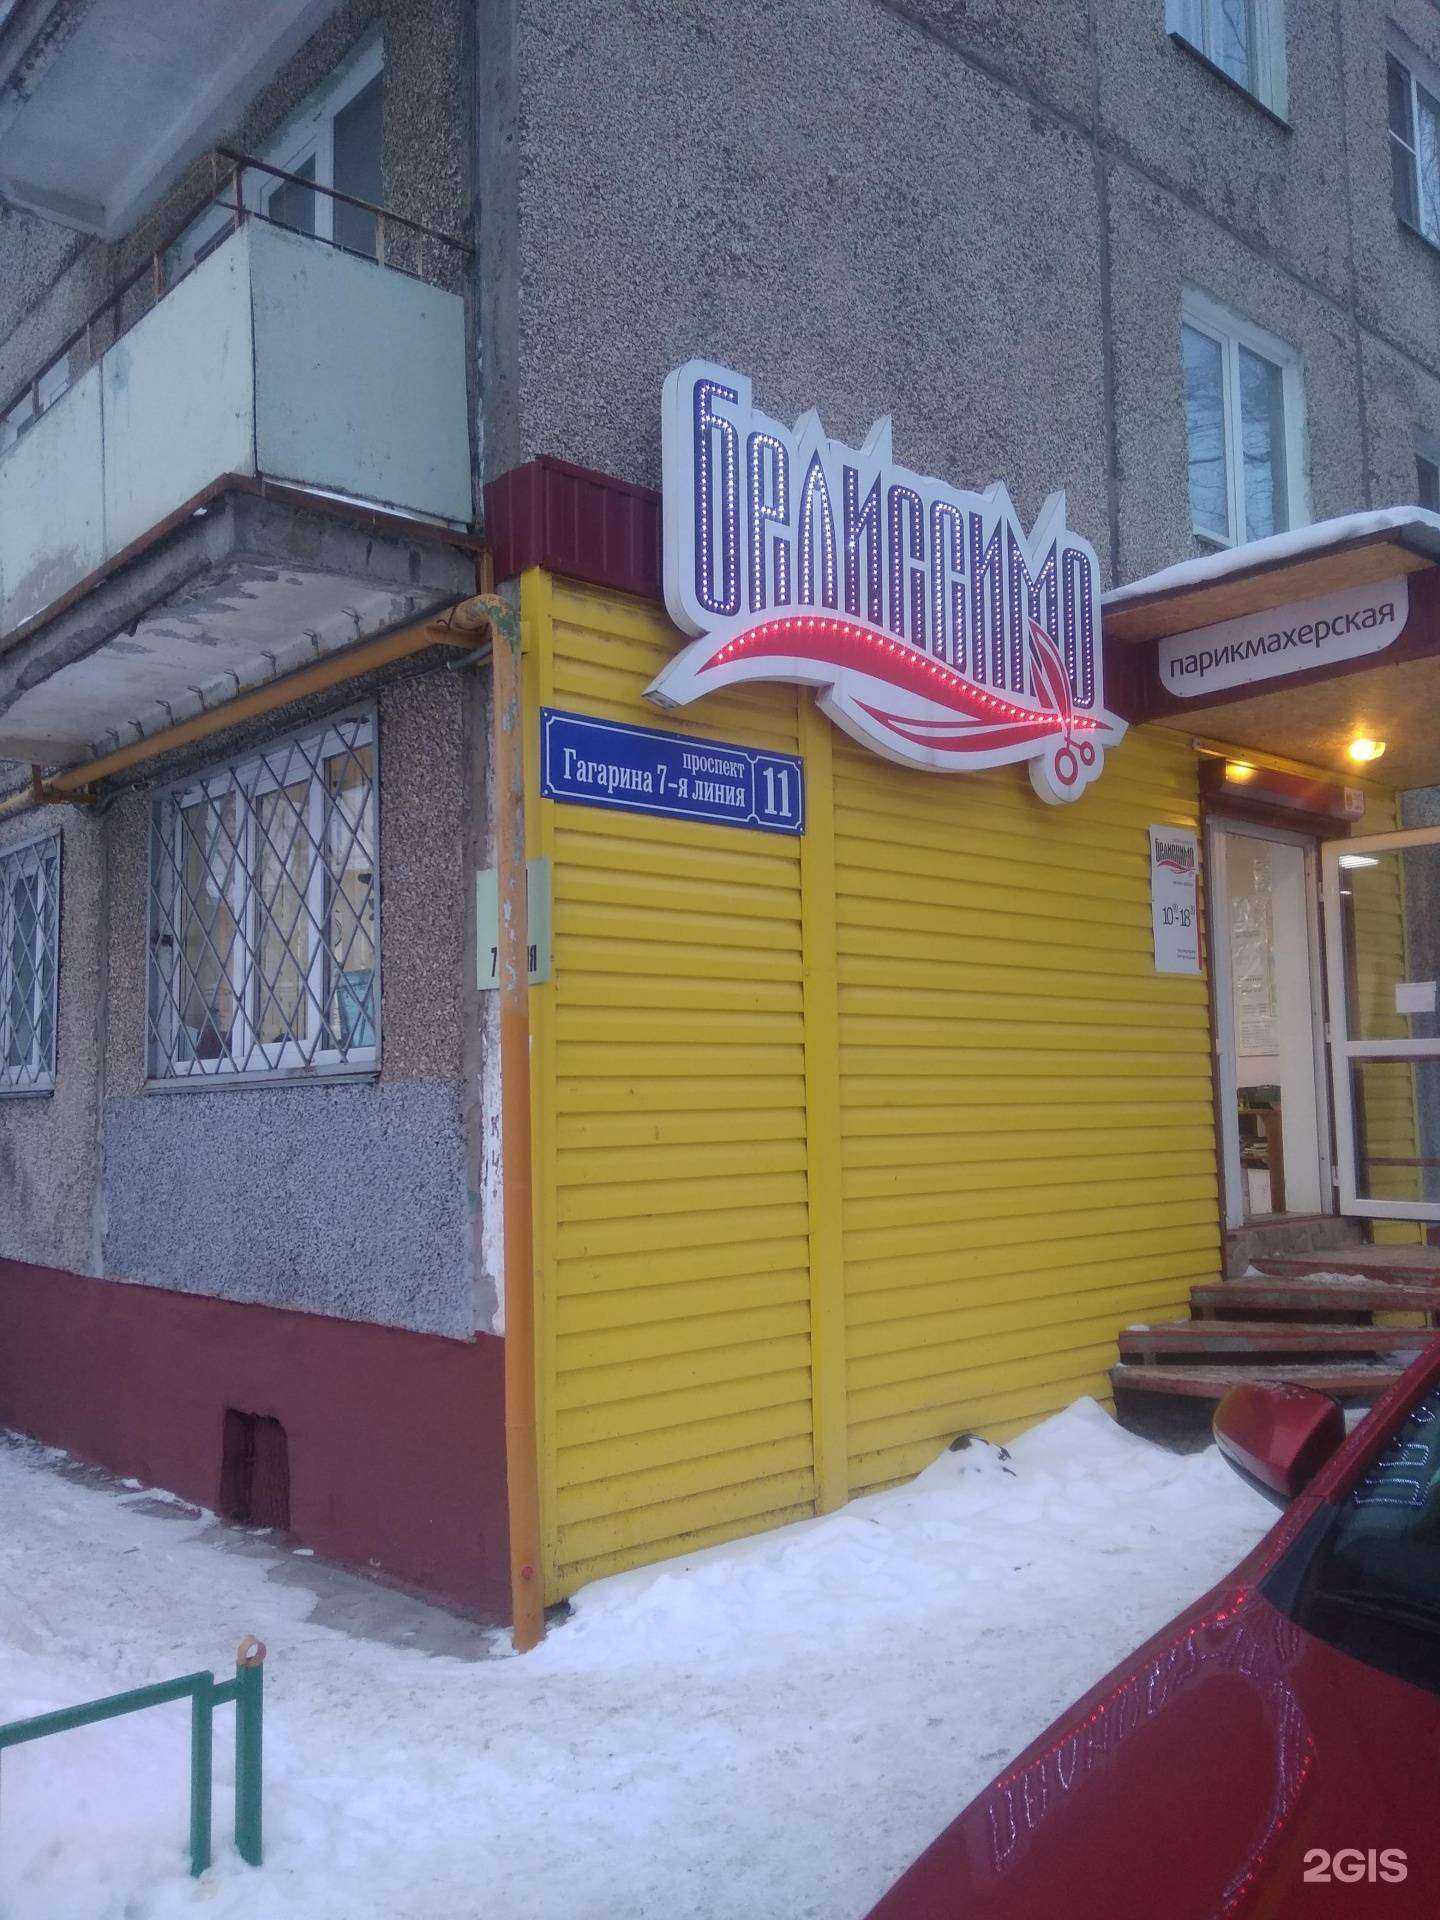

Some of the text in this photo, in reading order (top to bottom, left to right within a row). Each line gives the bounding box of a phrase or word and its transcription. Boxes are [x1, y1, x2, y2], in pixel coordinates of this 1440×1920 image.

[1169, 602, 1395, 677] парикмахерская
[563, 747, 746, 808] Гагарина 7-я линия
[682, 752, 745, 778] проспект
[762, 766, 792, 818] 11
